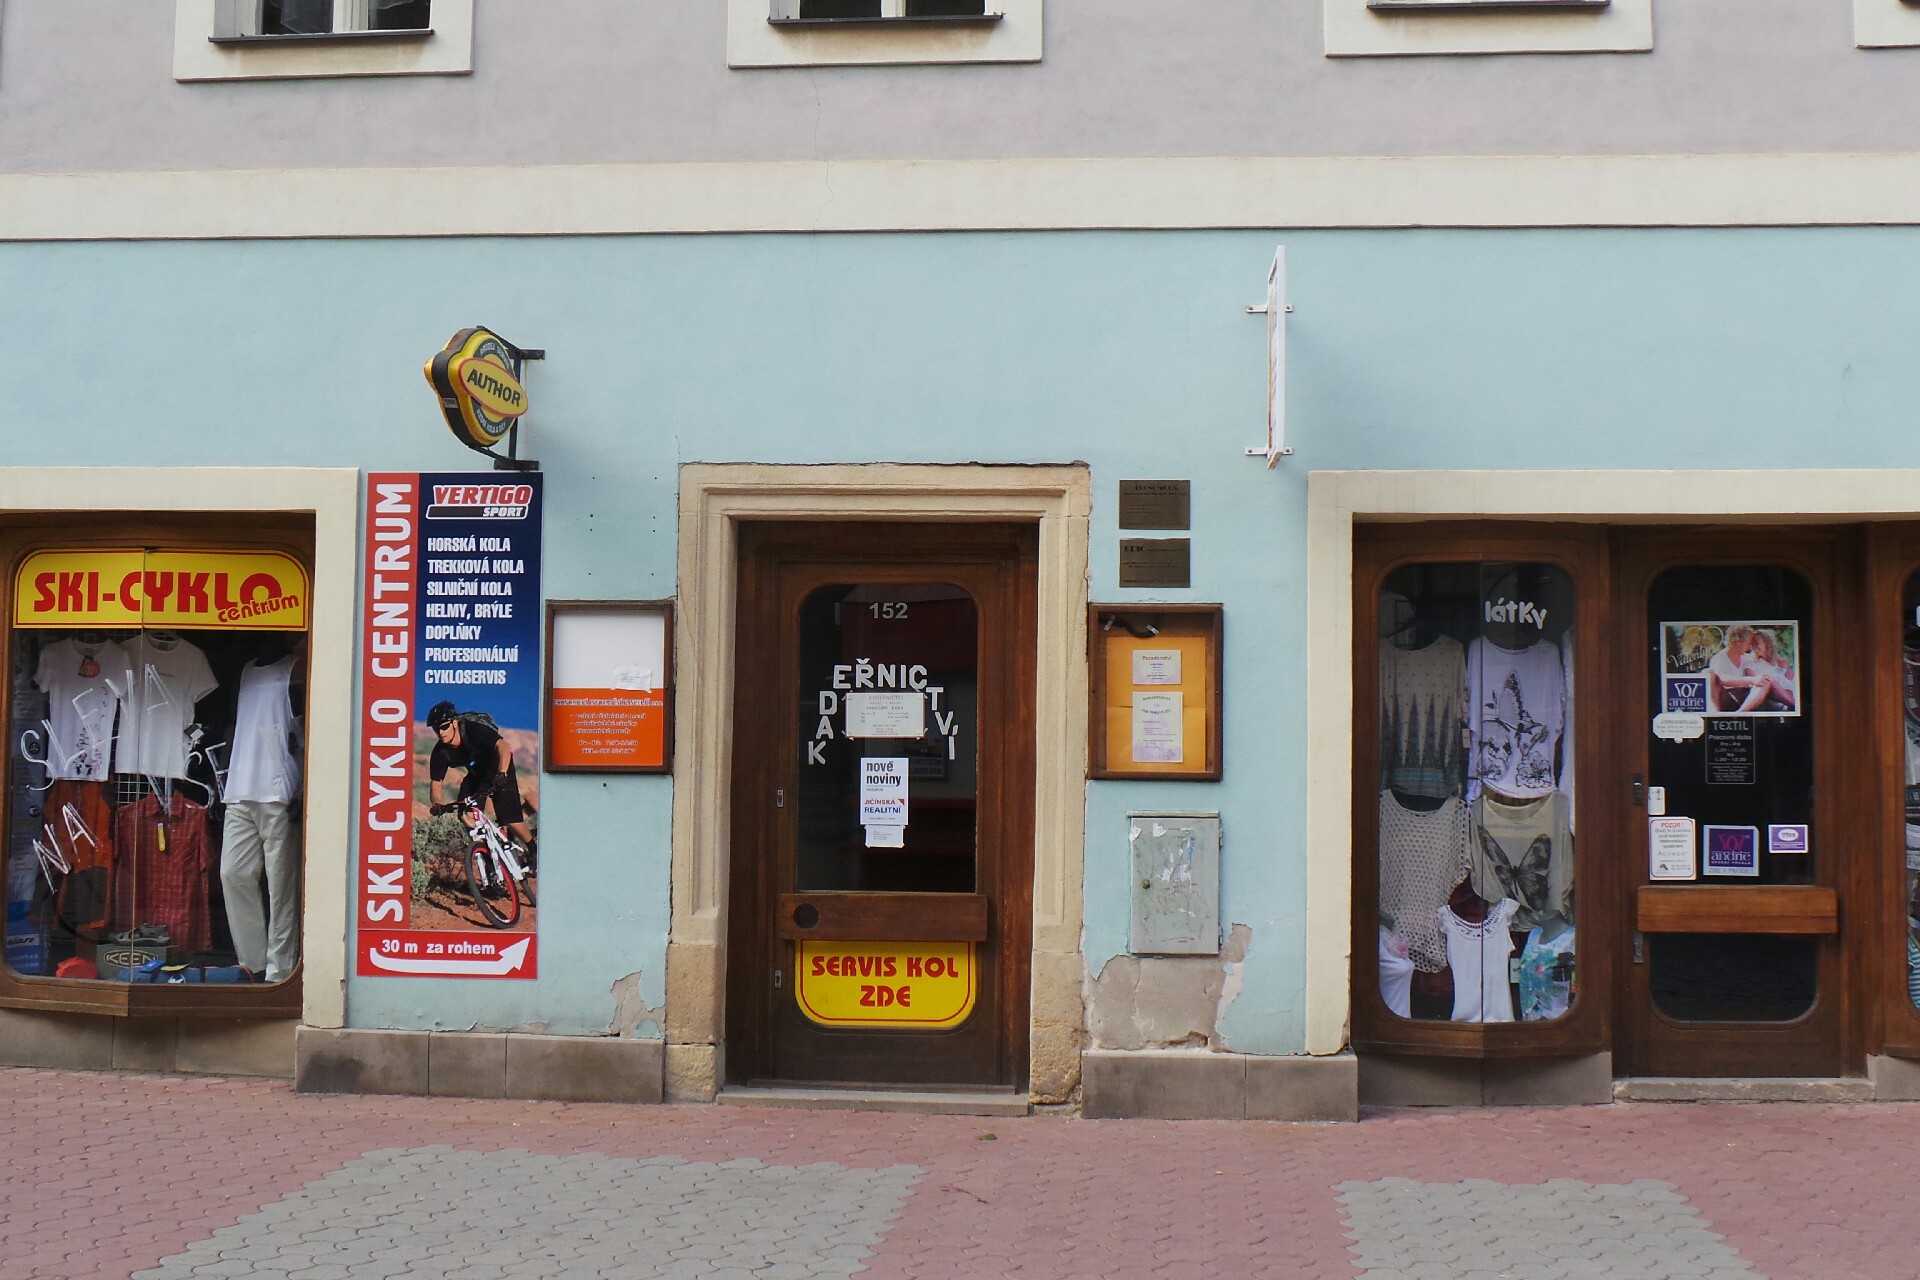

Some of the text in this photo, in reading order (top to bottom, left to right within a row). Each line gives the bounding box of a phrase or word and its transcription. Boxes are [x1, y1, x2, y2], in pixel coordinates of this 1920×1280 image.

[467, 369, 521, 407] AUTHOR
[432, 485, 533, 506] VERTIGO
[482, 506, 525, 518] SPORT
[427, 534, 511, 552] HORSKÁ KOLA
[427, 557, 524, 574] TREKKOVÁ KOLA
[33, 571, 283, 613] SKI-CYKLO
[426, 578, 512, 596] SILNIČNÍ KOLA
[217, 594, 300, 623] centrum
[425, 600, 513, 620] HELMY, BRÝLE
[869, 602, 908, 619] 152
[1484, 596, 1547, 630] látky
[425, 622, 482, 640] DOPLŇKY
[425, 644, 519, 663] PROFESIONÁLNÍ
[424, 669, 507, 684] CYKLOSERVIS
[366, 482, 412, 922] SKI-CYKLO CENTRUM
[1668, 697, 1704, 707] andrie
[1712, 720, 1749, 731] TEXTIL
[866, 761, 894, 772] nové
[866, 773, 902, 787] noviny
[864, 806, 901, 814] REALITNÍ
[31, 799, 101, 896] NA
[1710, 850, 1751, 861] andrie
[381, 939, 496, 955] 30 m za rohem
[106, 953, 157, 966] KEEN
[811, 955, 959, 978] SERVIS KOL
[859, 985, 911, 1008] ZDE
